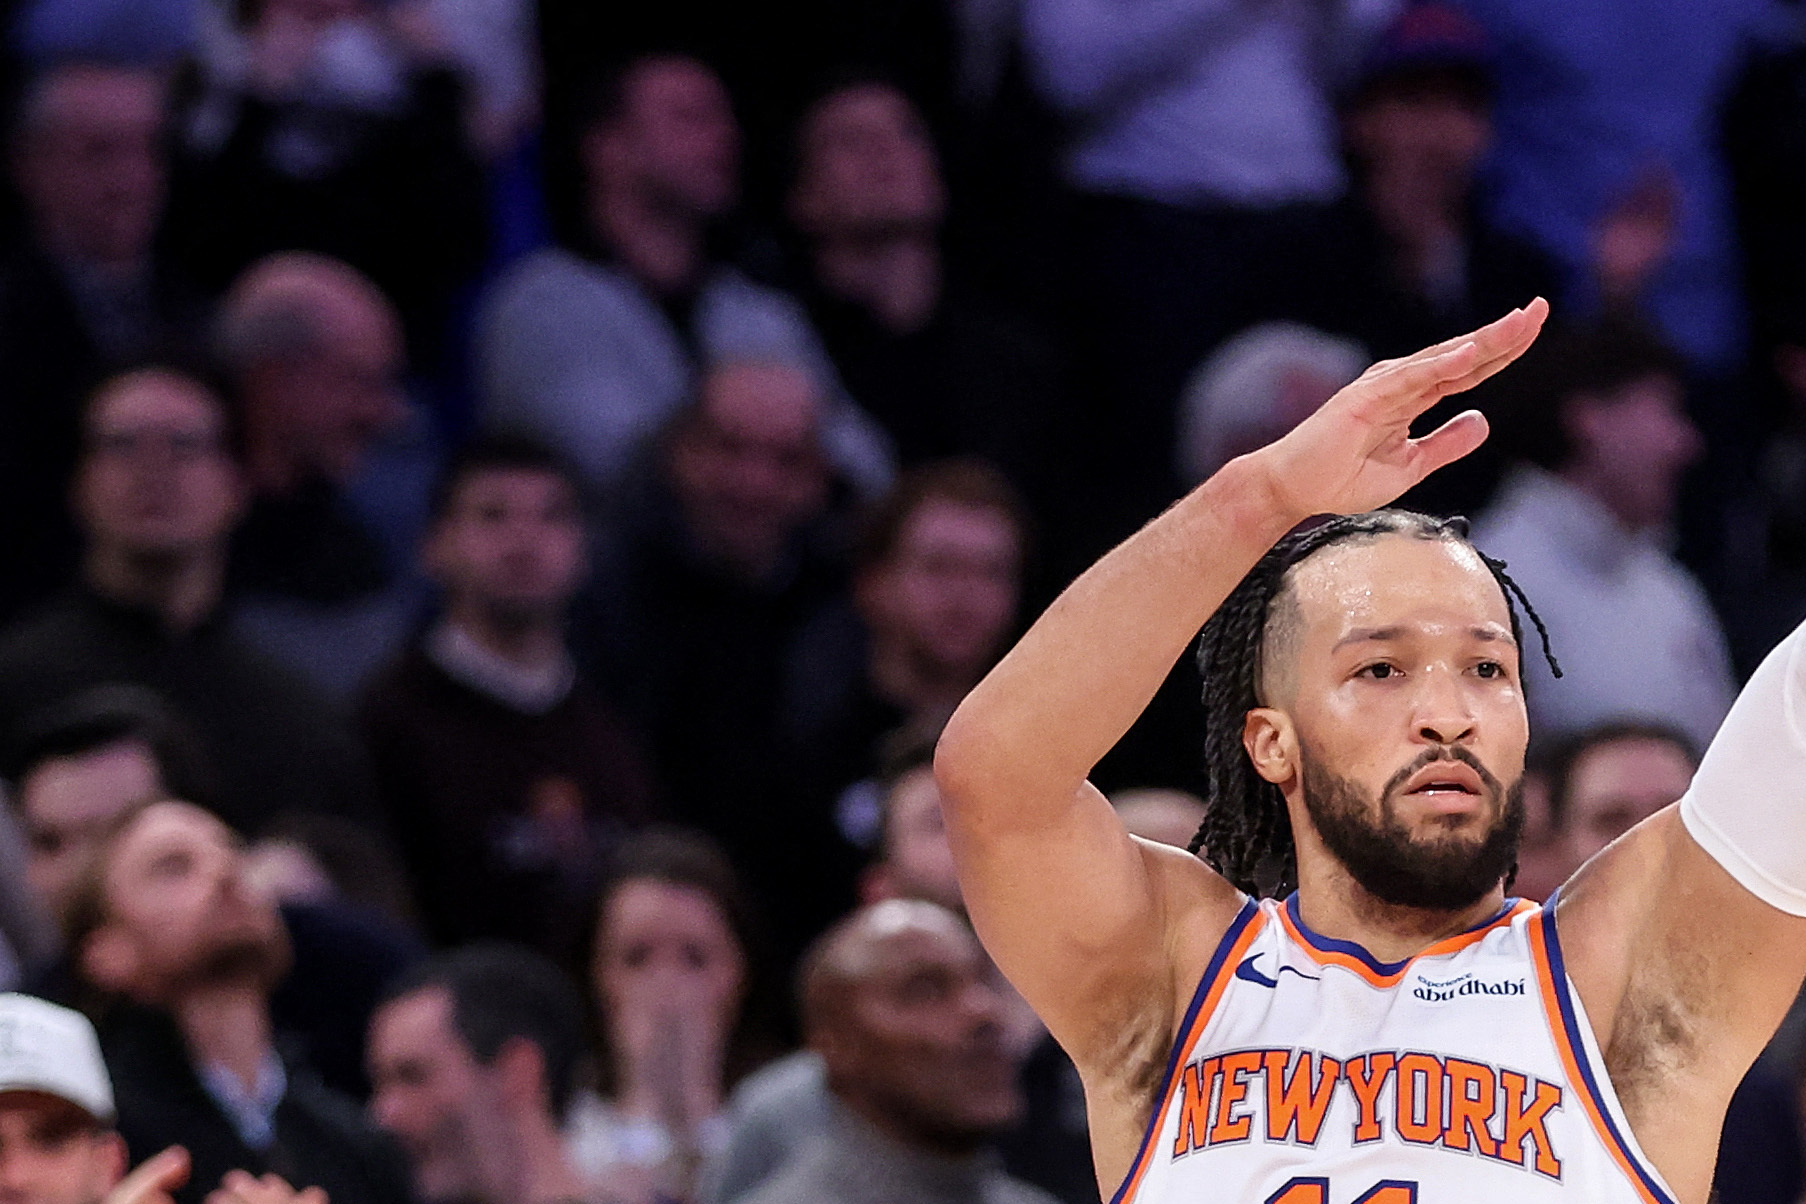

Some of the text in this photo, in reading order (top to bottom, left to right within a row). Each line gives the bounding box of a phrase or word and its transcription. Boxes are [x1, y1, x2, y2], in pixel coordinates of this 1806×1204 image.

[1413, 987, 1455, 1002] abu
[1172, 1047, 1564, 1184] NEW YORK
